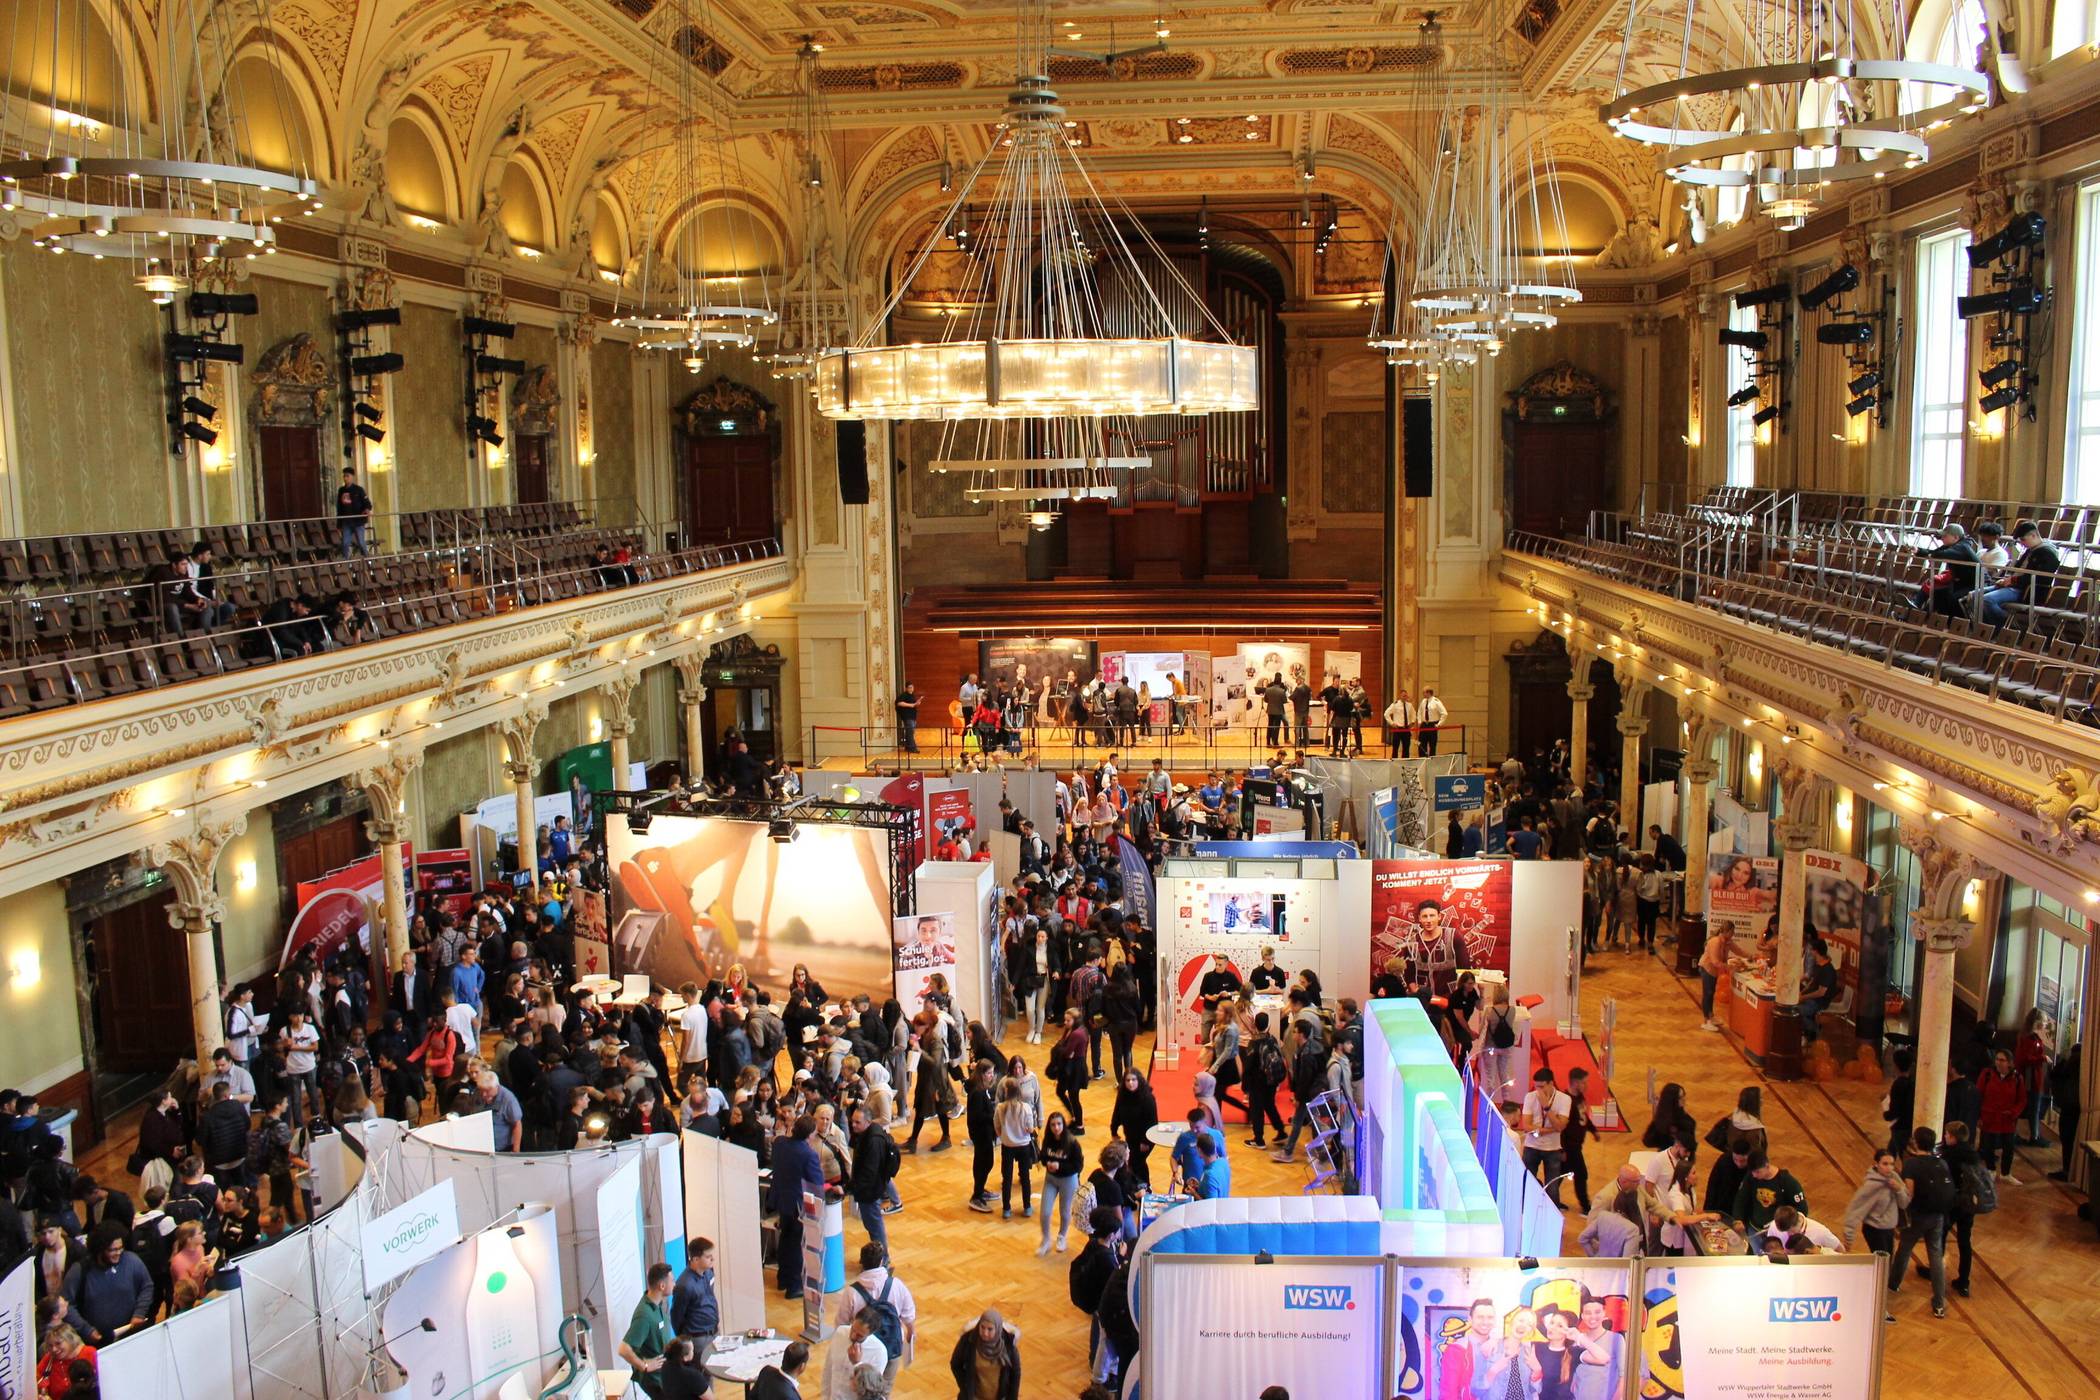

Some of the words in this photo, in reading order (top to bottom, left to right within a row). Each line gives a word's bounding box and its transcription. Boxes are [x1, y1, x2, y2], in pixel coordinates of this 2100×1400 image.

[1389, 871, 1418, 880] WILLST
[1420, 868, 1454, 878] ENDLICH
[1382, 880, 1422, 889] KOMMEN?
[1424, 877, 1447, 885] JETZT
[898, 944, 933, 957] Schule,
[899, 957, 929, 968] fertig,
[931, 954, 948, 963] los.
[383, 1212, 440, 1253] VORWERK
[1199, 1330, 1231, 1339] Karriere
[1233, 1330, 1256, 1339] durch
[1258, 1330, 1299, 1339] berufliche
[1301, 1331, 1351, 1341] Ausbildung!
[1708, 1347, 1734, 1355] Meine
[1760, 1346, 1787, 1354] Meine
[1788, 1345, 1834, 1354] Stadtwerke.
[1758, 1357, 1785, 1365] Meine
[1786, 1357, 1834, 1367] Ausbildung.
[1718, 1384, 1736, 1392] WSW
[1737, 1384, 1776, 1393] Wuppertaler
[1776, 1383, 1811, 1391] Stadtwerke
[1812, 1383, 1833, 1391] GmbH
[1747, 1392, 1765, 1400] WSW
[1766, 1392, 1788, 1400] Energie
